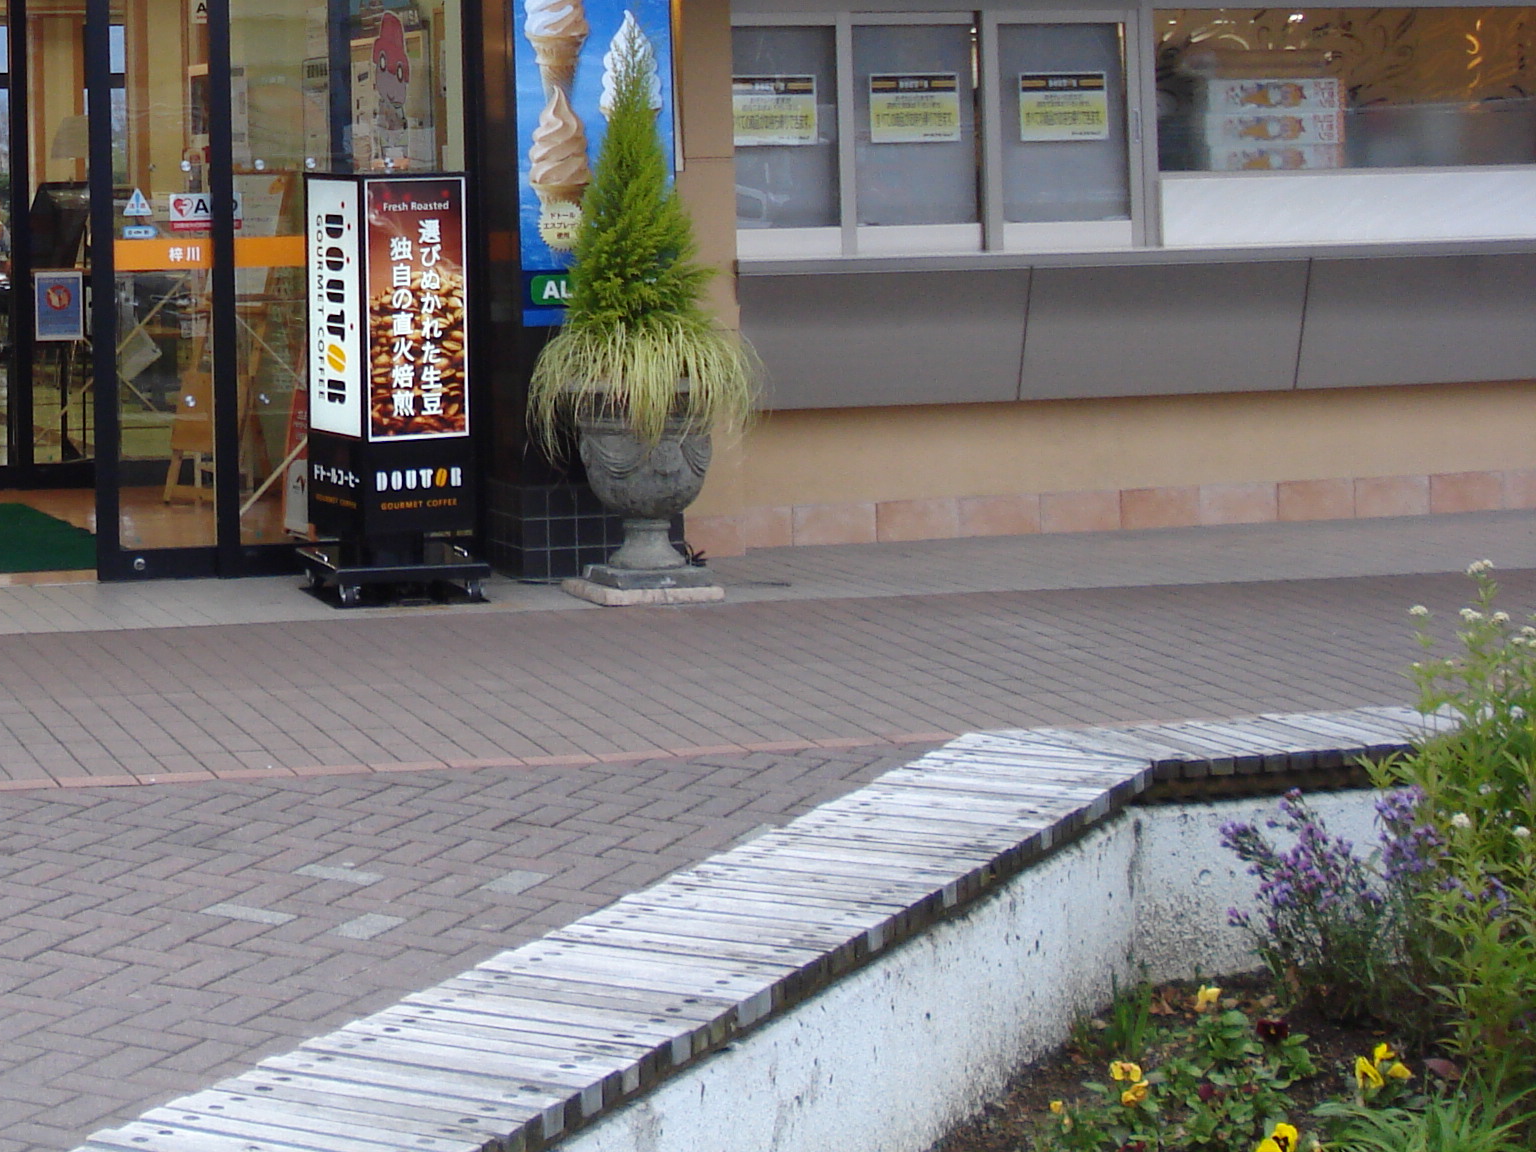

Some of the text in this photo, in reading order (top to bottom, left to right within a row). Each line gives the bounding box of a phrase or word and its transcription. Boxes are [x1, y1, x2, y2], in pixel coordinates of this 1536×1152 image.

[383, 201, 450, 212] Fresh Roasted
[544, 222, 581, 230] エスプレッ
[169, 246, 201, 262] 梓川
[543, 280, 573, 300] AL
[316, 214, 325, 399] GOURMET COFFEE
[325, 214, 346, 405] DOUTOR
[418, 219, 443, 416] 選びぬかれた生豆
[390, 236, 415, 417] 独自の直火焙煎
[313, 464, 360, 488] ドトールコーヒー
[376, 467, 462, 492] DOUTOR
[381, 498, 458, 511] GOURMET COFFEE
